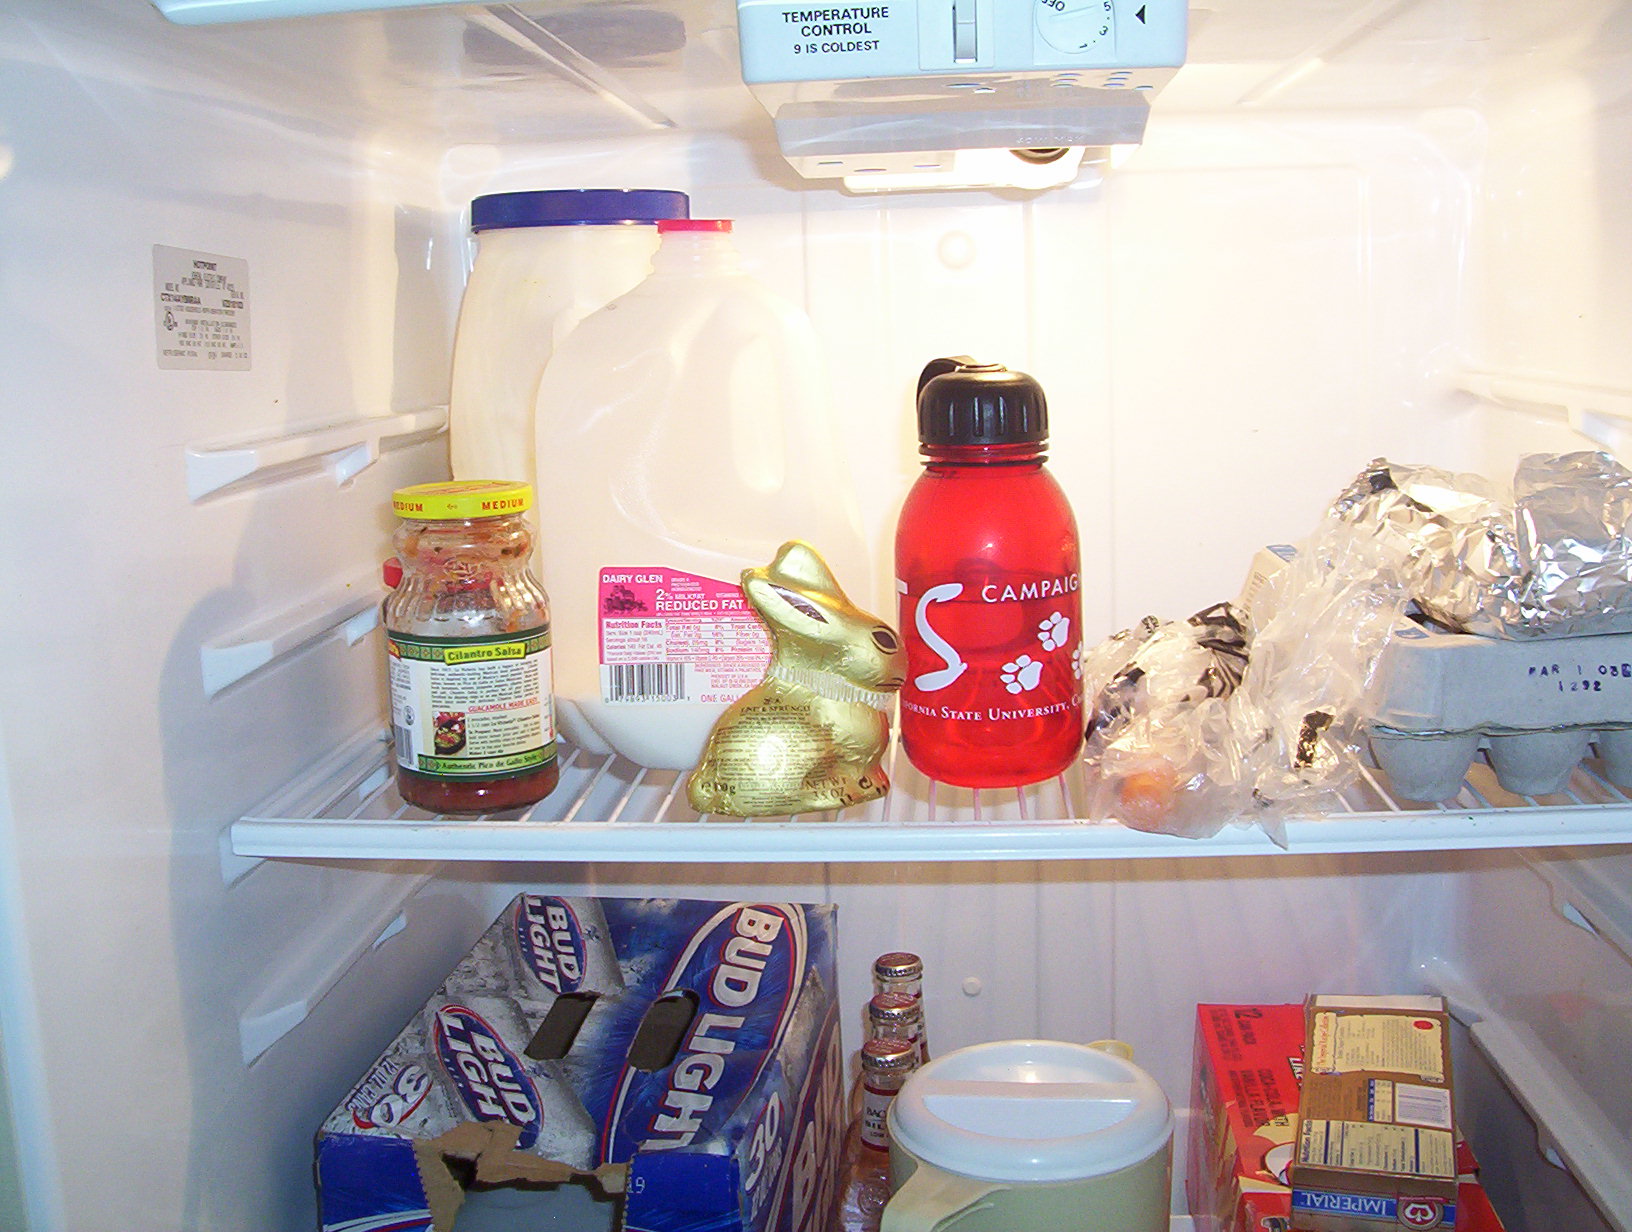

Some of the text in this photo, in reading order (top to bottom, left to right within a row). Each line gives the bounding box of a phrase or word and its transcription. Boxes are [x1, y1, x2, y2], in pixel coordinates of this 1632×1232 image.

[782, 7, 889, 23] TEMPERATURE
[801, 22, 872, 37] CONTROL
[794, 40, 880, 54] 9 IS COLDEST
[482, 498, 524, 510] MEDIUM
[602, 574, 663, 584] DAIRY GLEN
[655, 599, 744, 611] REDUCED FAT
[447, 644, 523, 662] Cilantro Salsa
[700, 694, 717, 702] ONE
[524, 896, 562, 994] LIGHT
[546, 905, 582, 981] BUD
[713, 907, 785, 1008] BUD
[436, 1011, 512, 1124] LIGH
[470, 1031, 536, 1124] BUD
[371, 1064, 429, 1128] 30
[745, 1091, 780, 1192] 30
[1302, 1191, 1387, 1216] IMPERIAL
